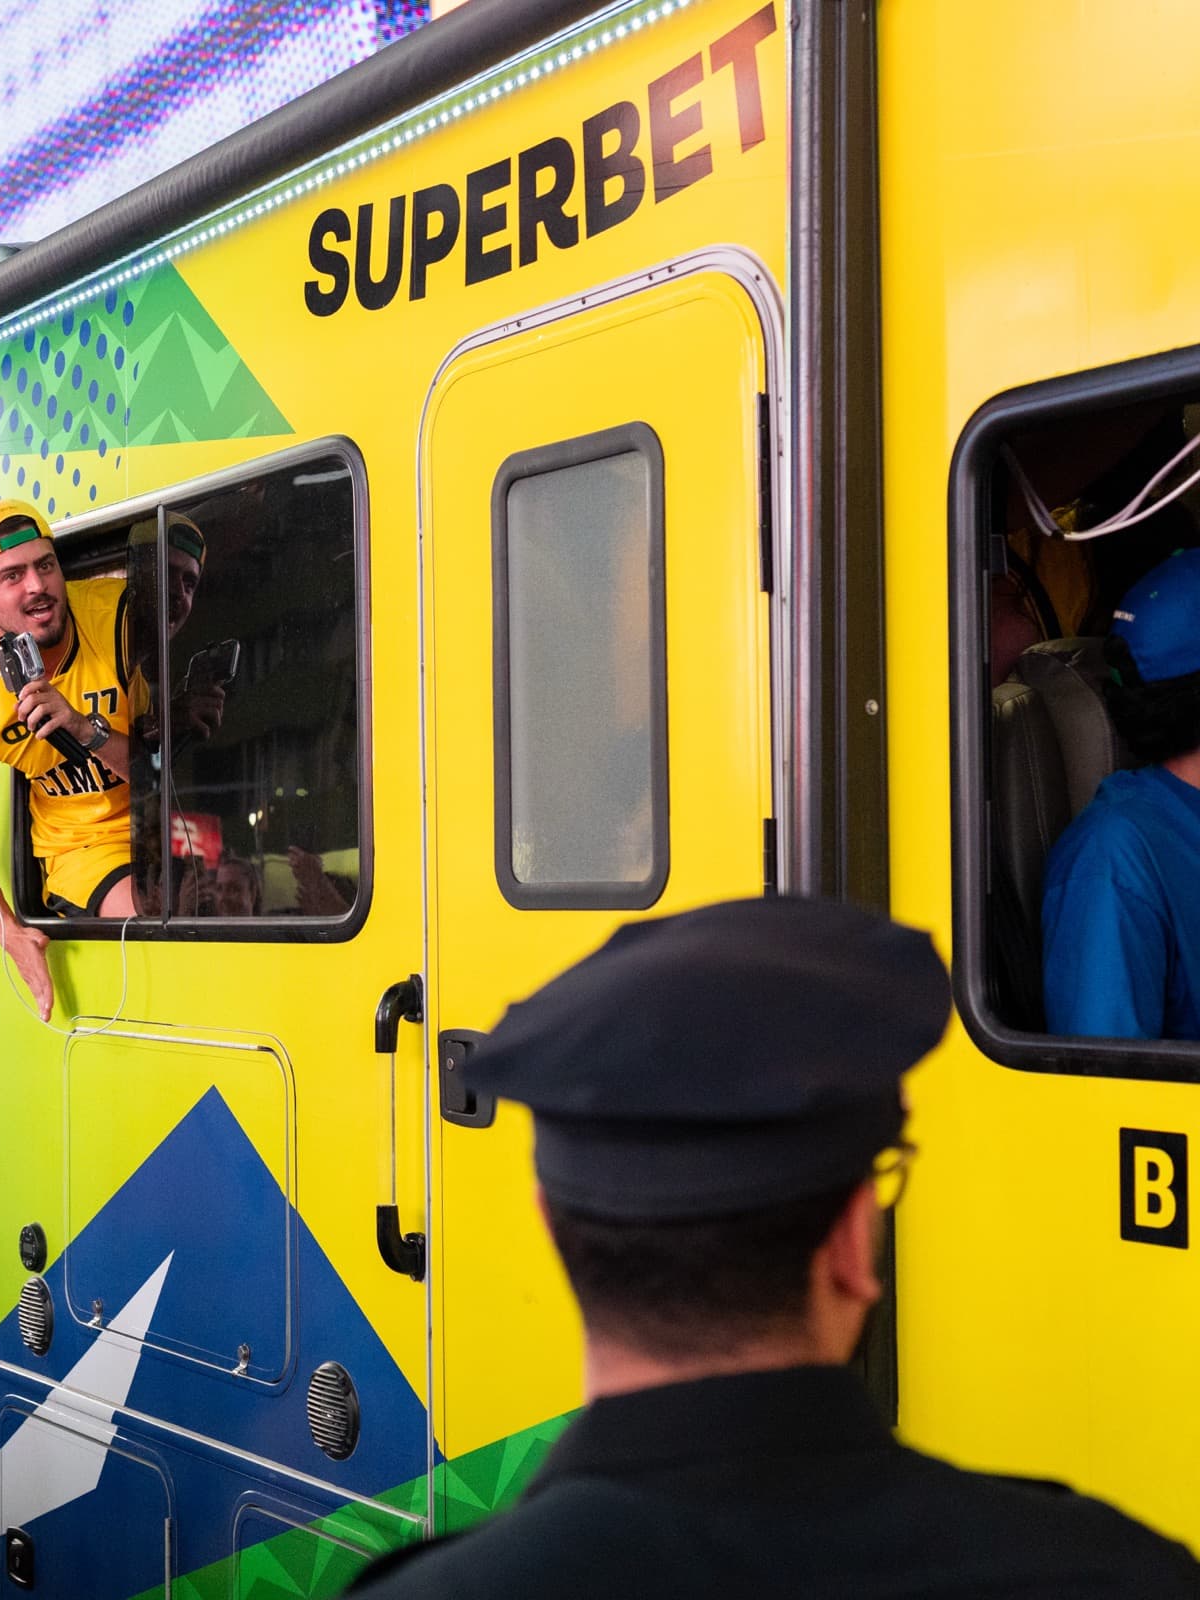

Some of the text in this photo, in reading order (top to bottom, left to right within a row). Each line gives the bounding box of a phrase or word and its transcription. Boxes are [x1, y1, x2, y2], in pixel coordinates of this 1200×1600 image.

[303, 1, 777, 317] SUPERBET
[83, 687, 118, 715] 77
[1131, 1143, 1180, 1232] B
